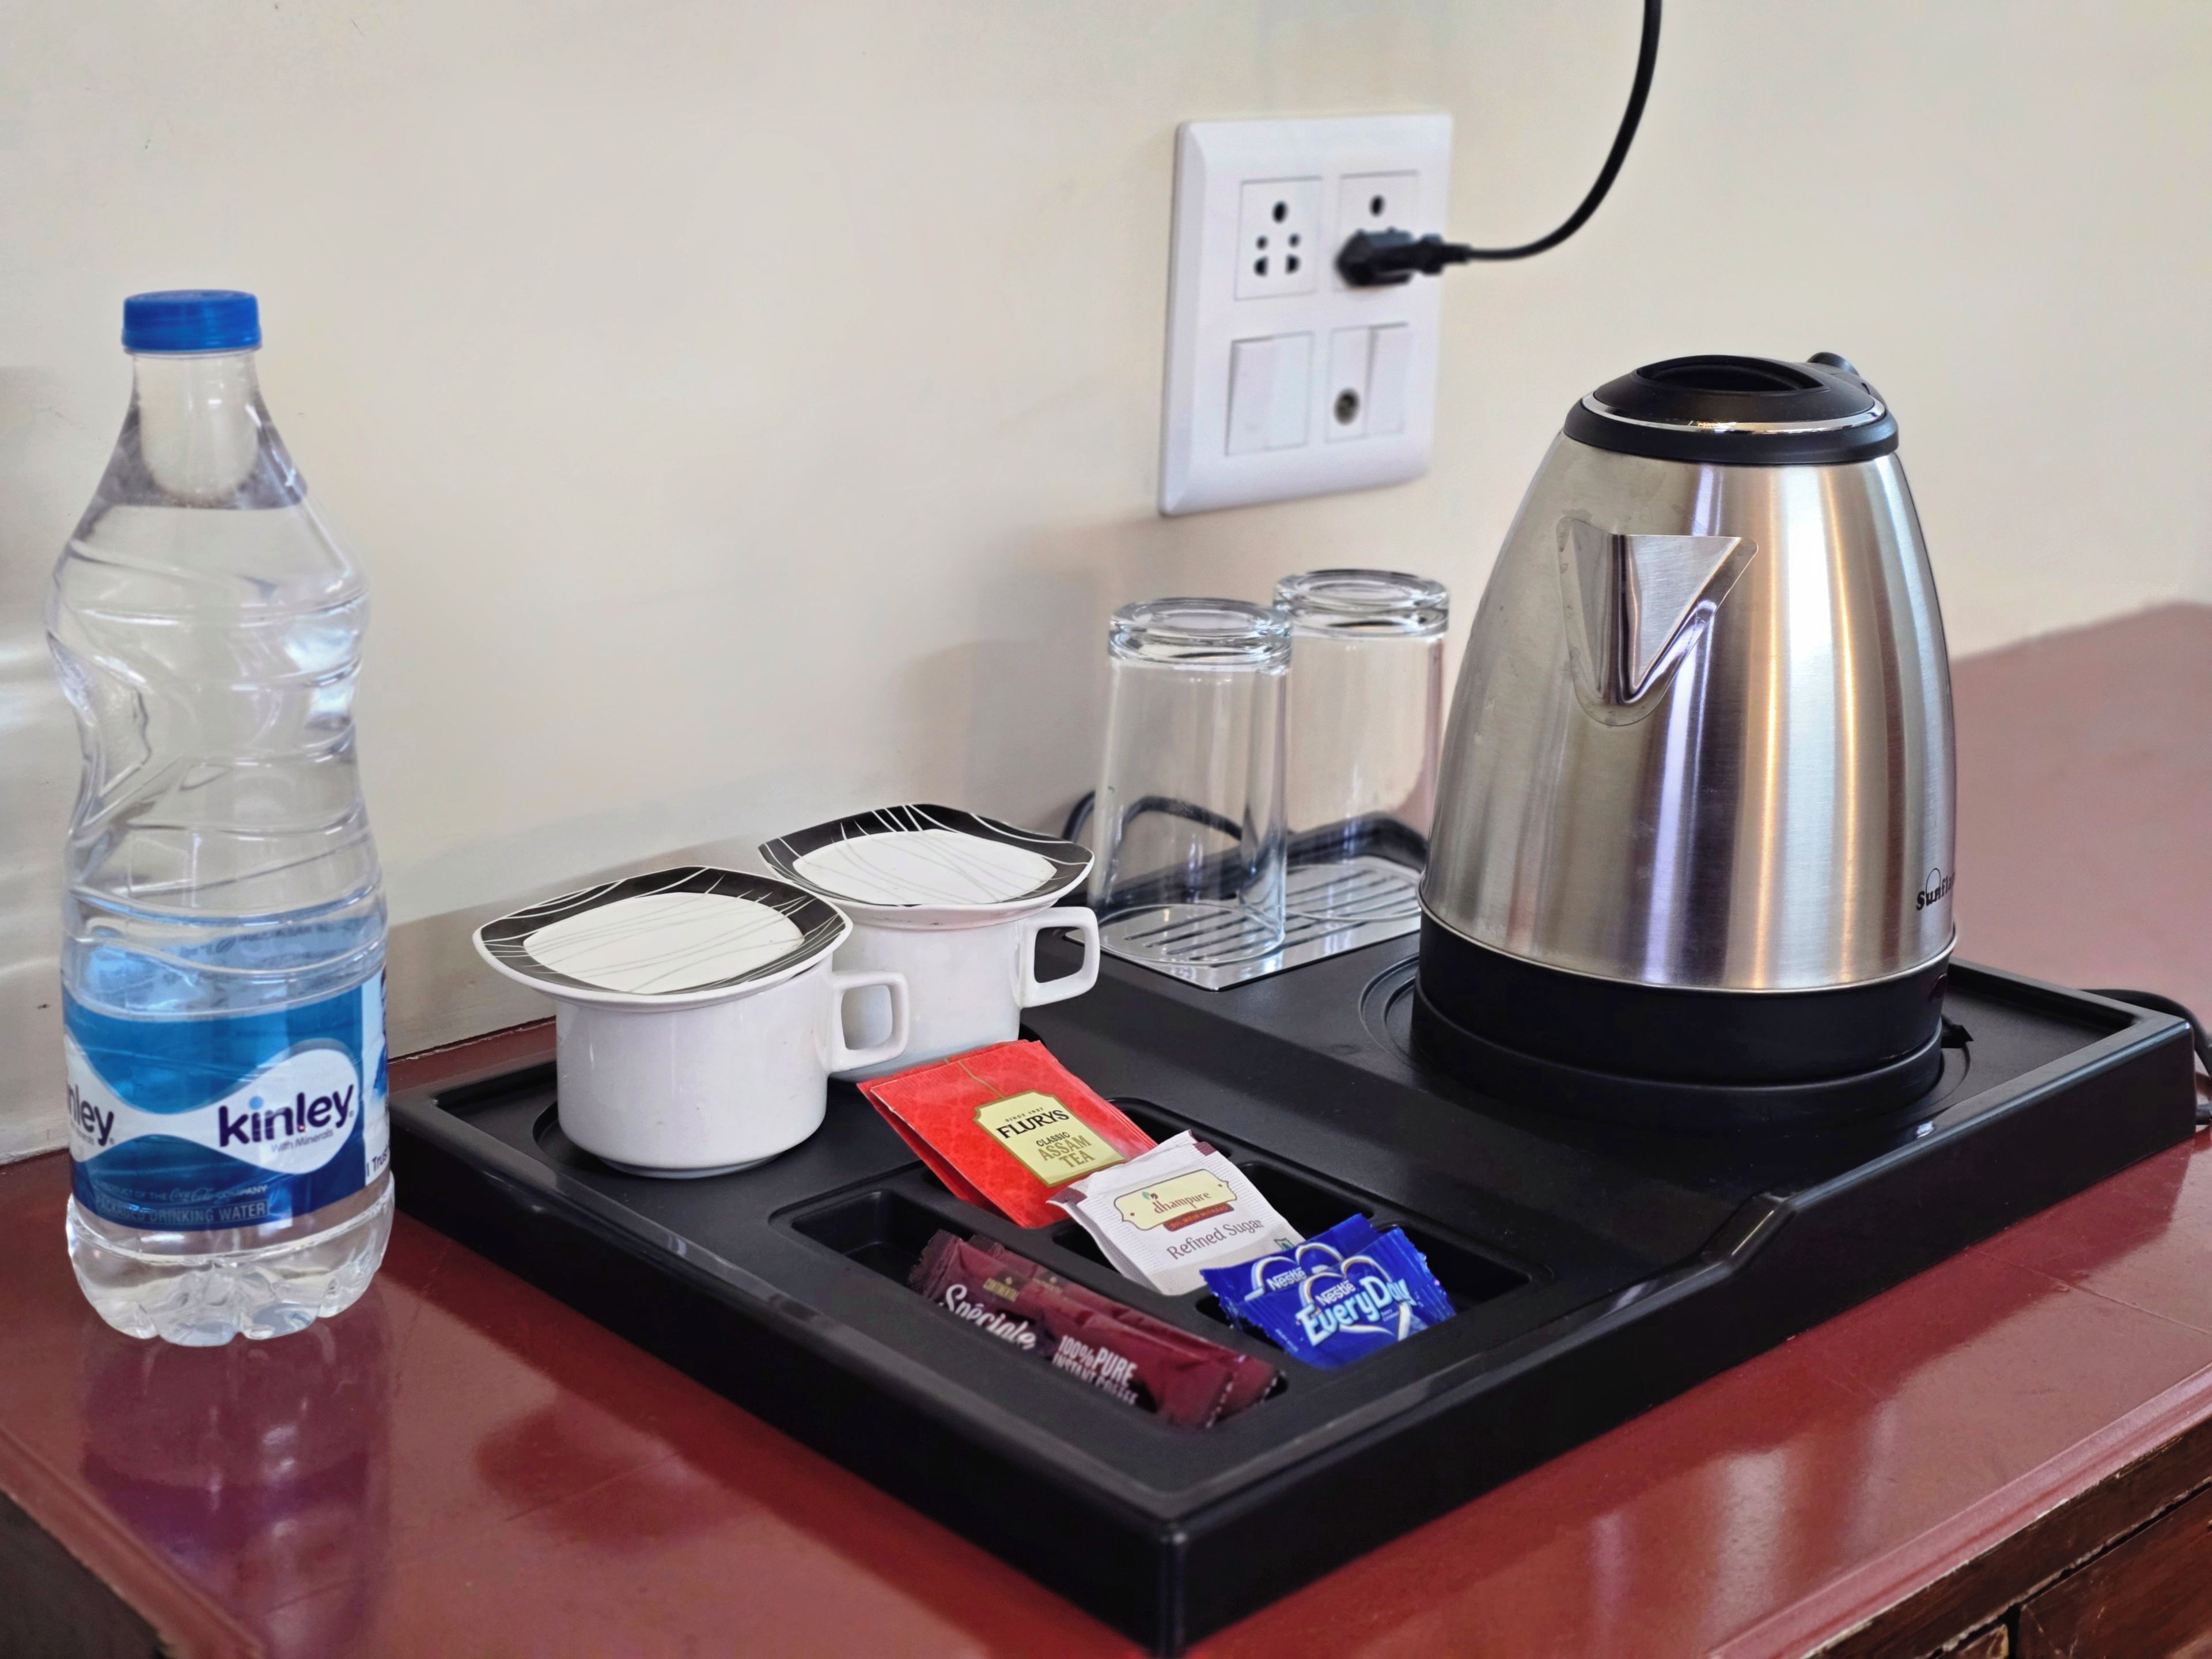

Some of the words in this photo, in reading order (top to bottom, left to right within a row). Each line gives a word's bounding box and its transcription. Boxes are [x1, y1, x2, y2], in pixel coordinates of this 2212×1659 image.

[67, 1084, 114, 1147] nley
[219, 1084, 354, 1147] kinley
[996, 1109, 1069, 1139] FLURYS
[1005, 1113, 1026, 1122] SINCE
[1036, 1131, 1070, 1147] CLASSIC
[1037, 1135, 1092, 1161] ASSAM
[1058, 1150, 1096, 1168] TEA
[149, 1208, 214, 1224] DRINKING
[219, 1202, 266, 1221] WATER
[1152, 1191, 1212, 1214] dhampure
[1166, 1224, 1227, 1260] Refined
[1223, 1218, 1264, 1237] Sugar
[1092, 1347, 1138, 1387] PURE
